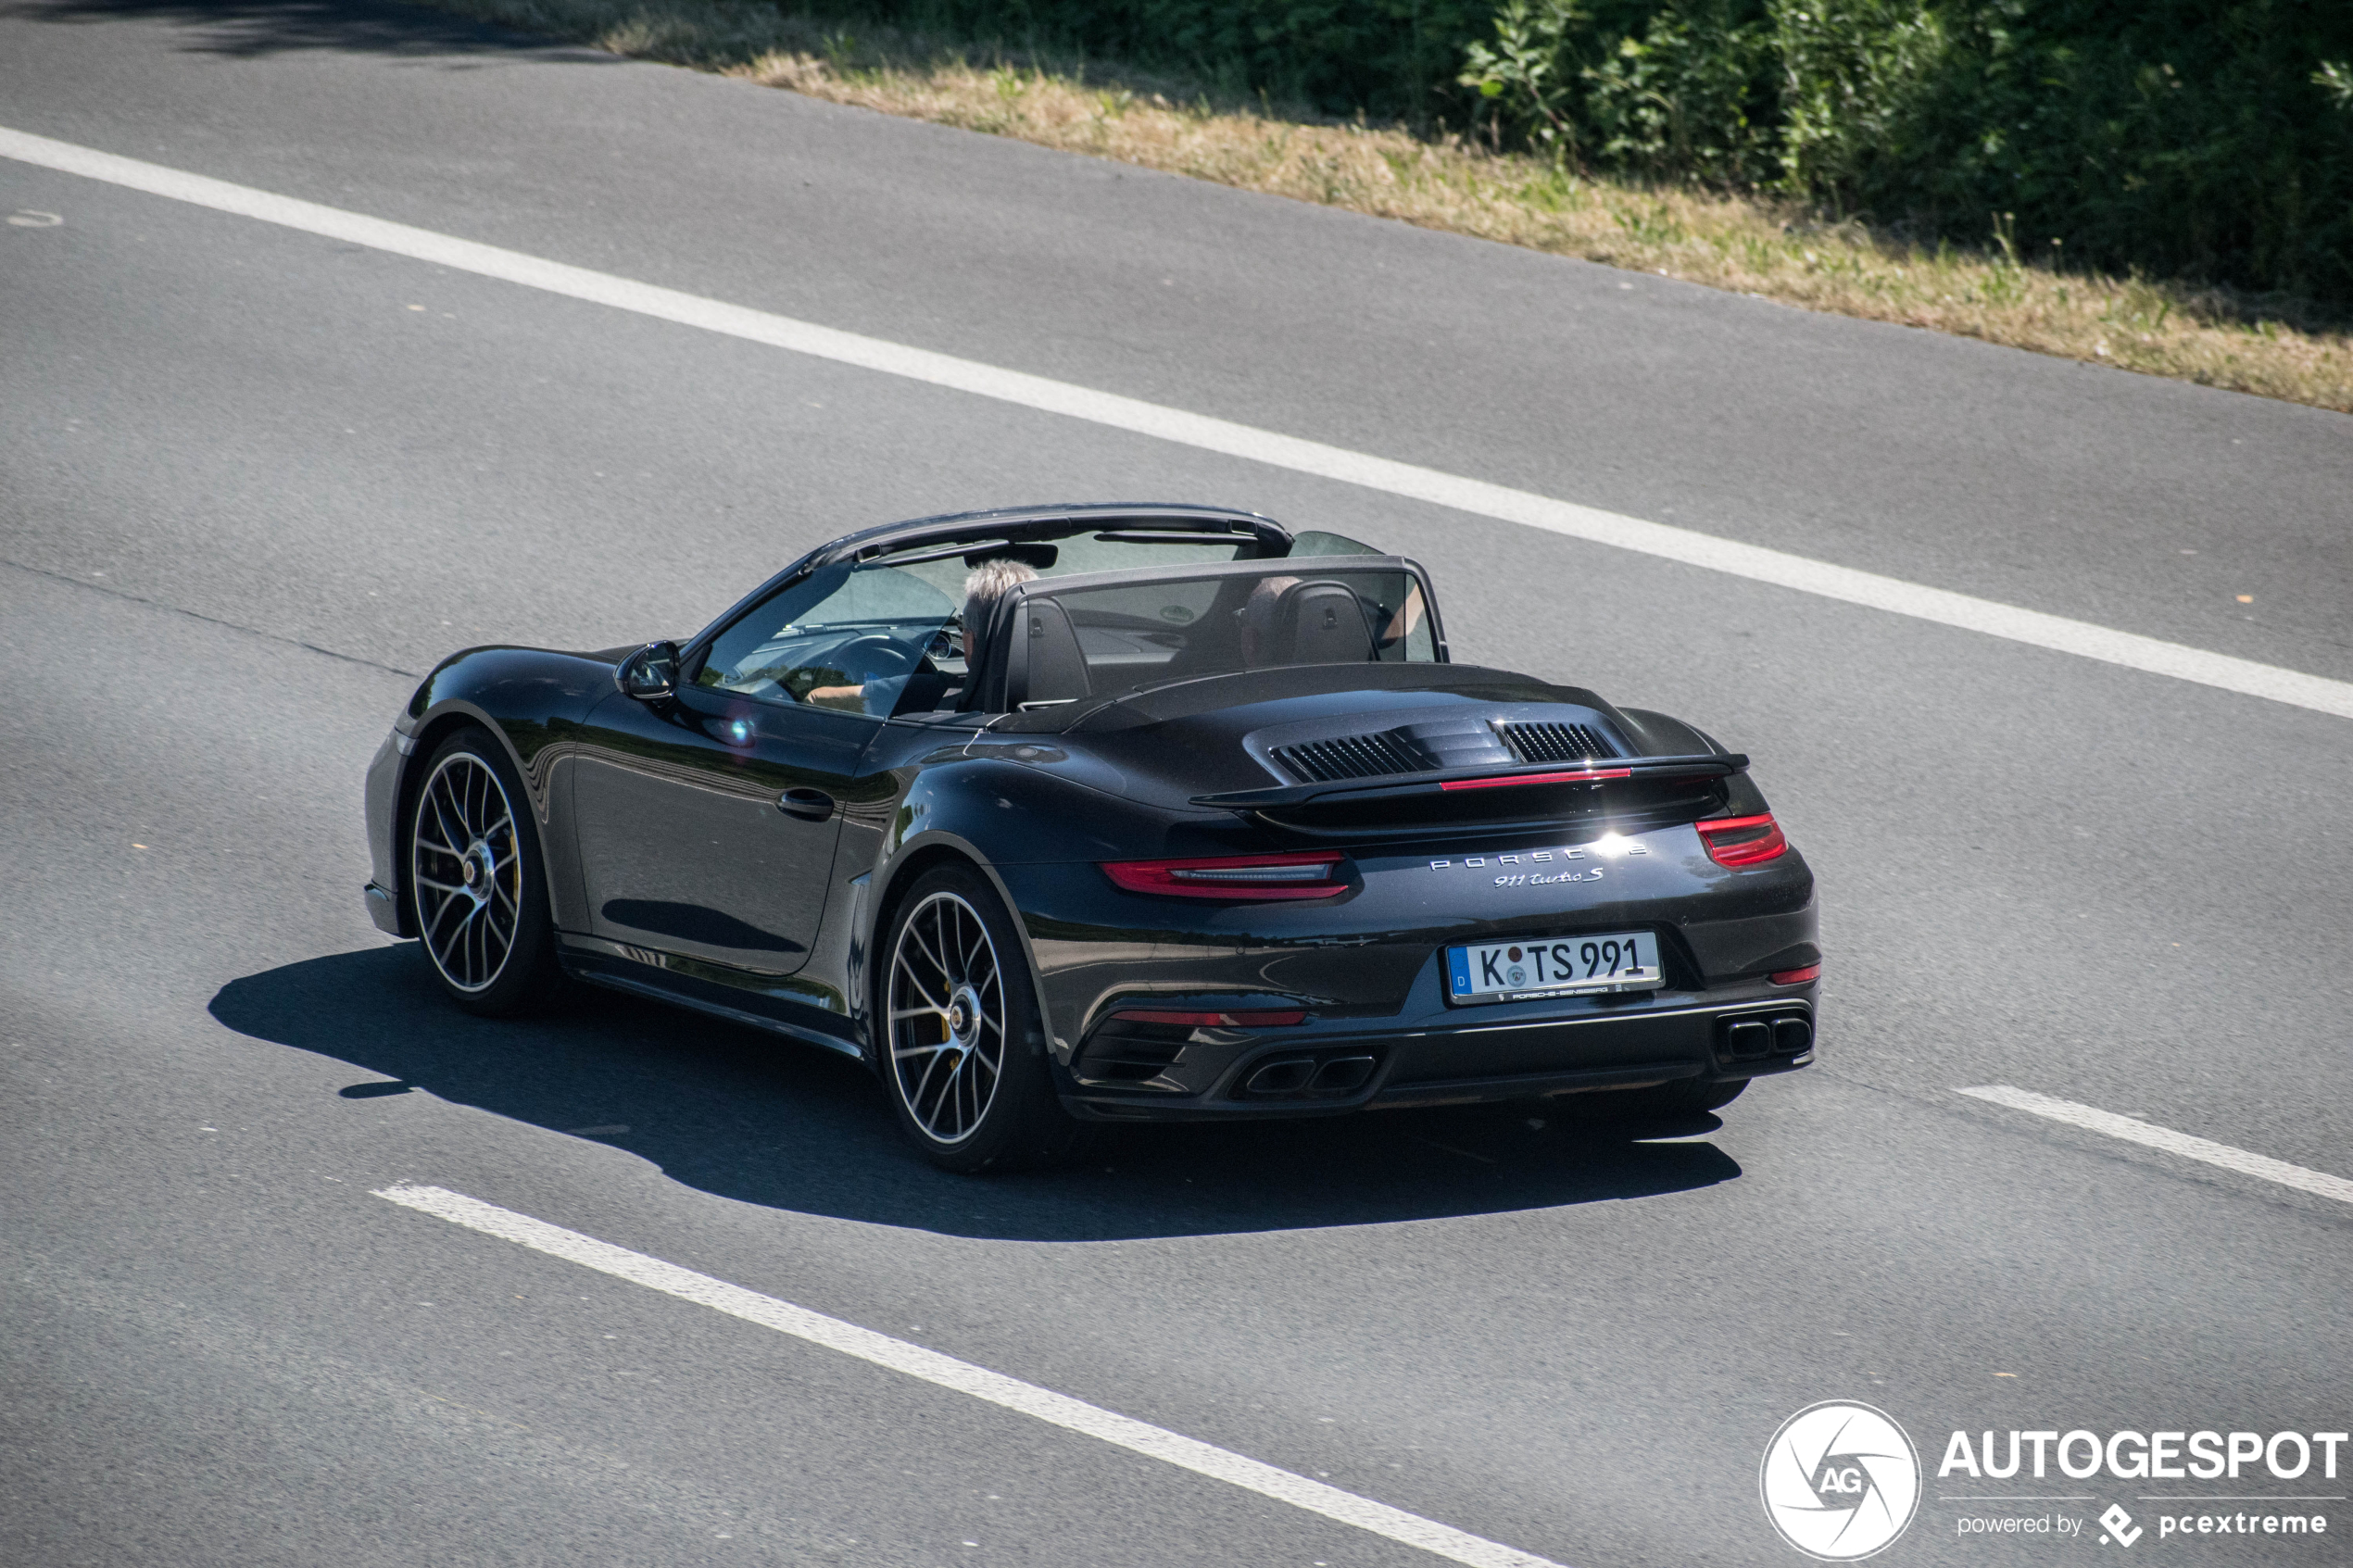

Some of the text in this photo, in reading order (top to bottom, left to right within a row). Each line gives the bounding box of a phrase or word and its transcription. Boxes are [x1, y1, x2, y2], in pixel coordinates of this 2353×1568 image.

[1430, 844, 1647, 871] PORSCE
[1494, 874, 1525, 888] 911
[1582, 867, 1604, 883] S
[1481, 949, 1505, 986] K
[1457, 976, 1466, 986] D
